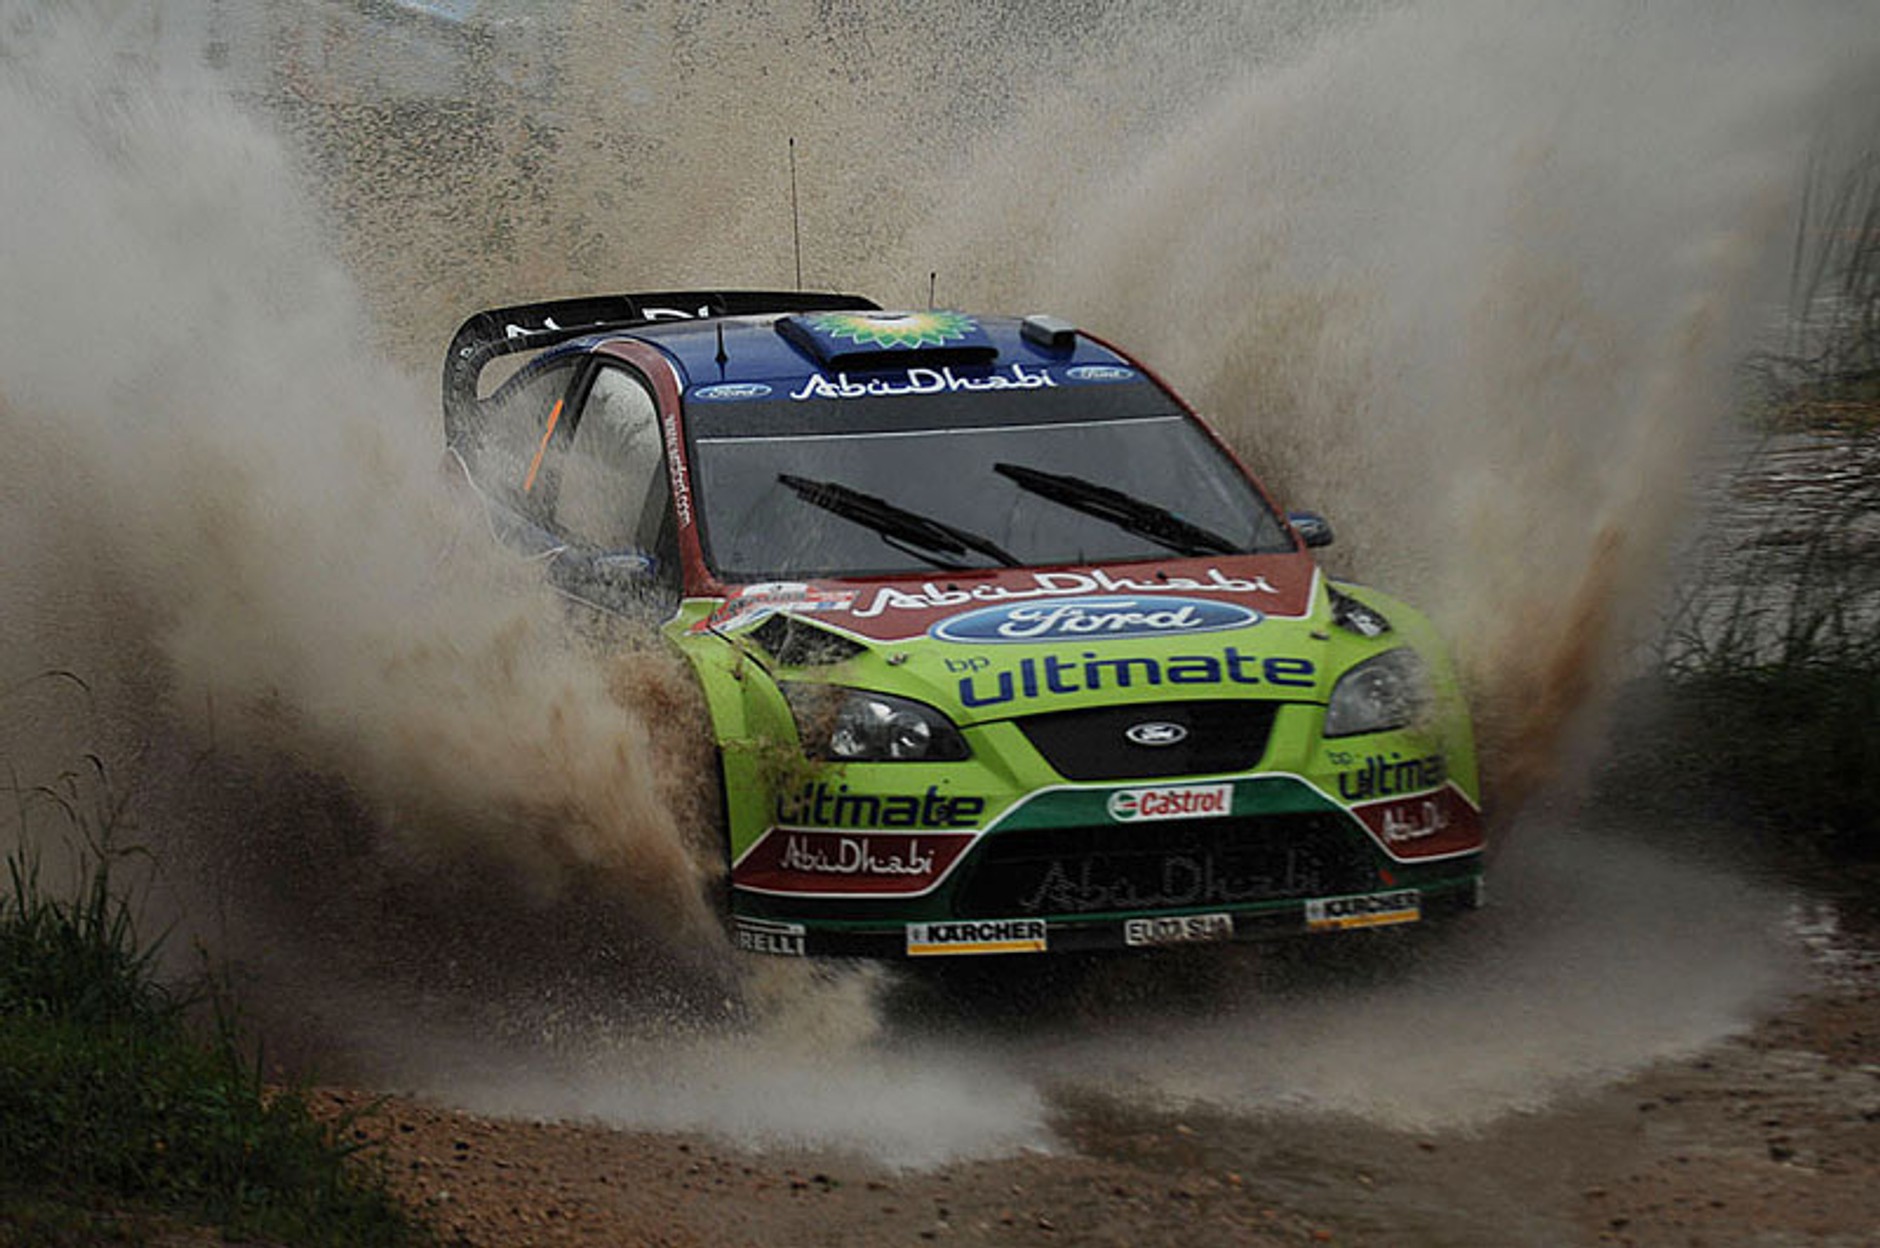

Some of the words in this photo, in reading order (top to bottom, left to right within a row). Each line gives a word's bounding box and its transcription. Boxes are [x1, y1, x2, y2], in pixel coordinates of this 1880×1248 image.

[998, 601, 1203, 637] Ford
[944, 656, 990, 674] bp
[959, 647, 1315, 709] ultimate
[776, 781, 985, 827] ultimate
[1140, 789, 1225, 817] Castrol
